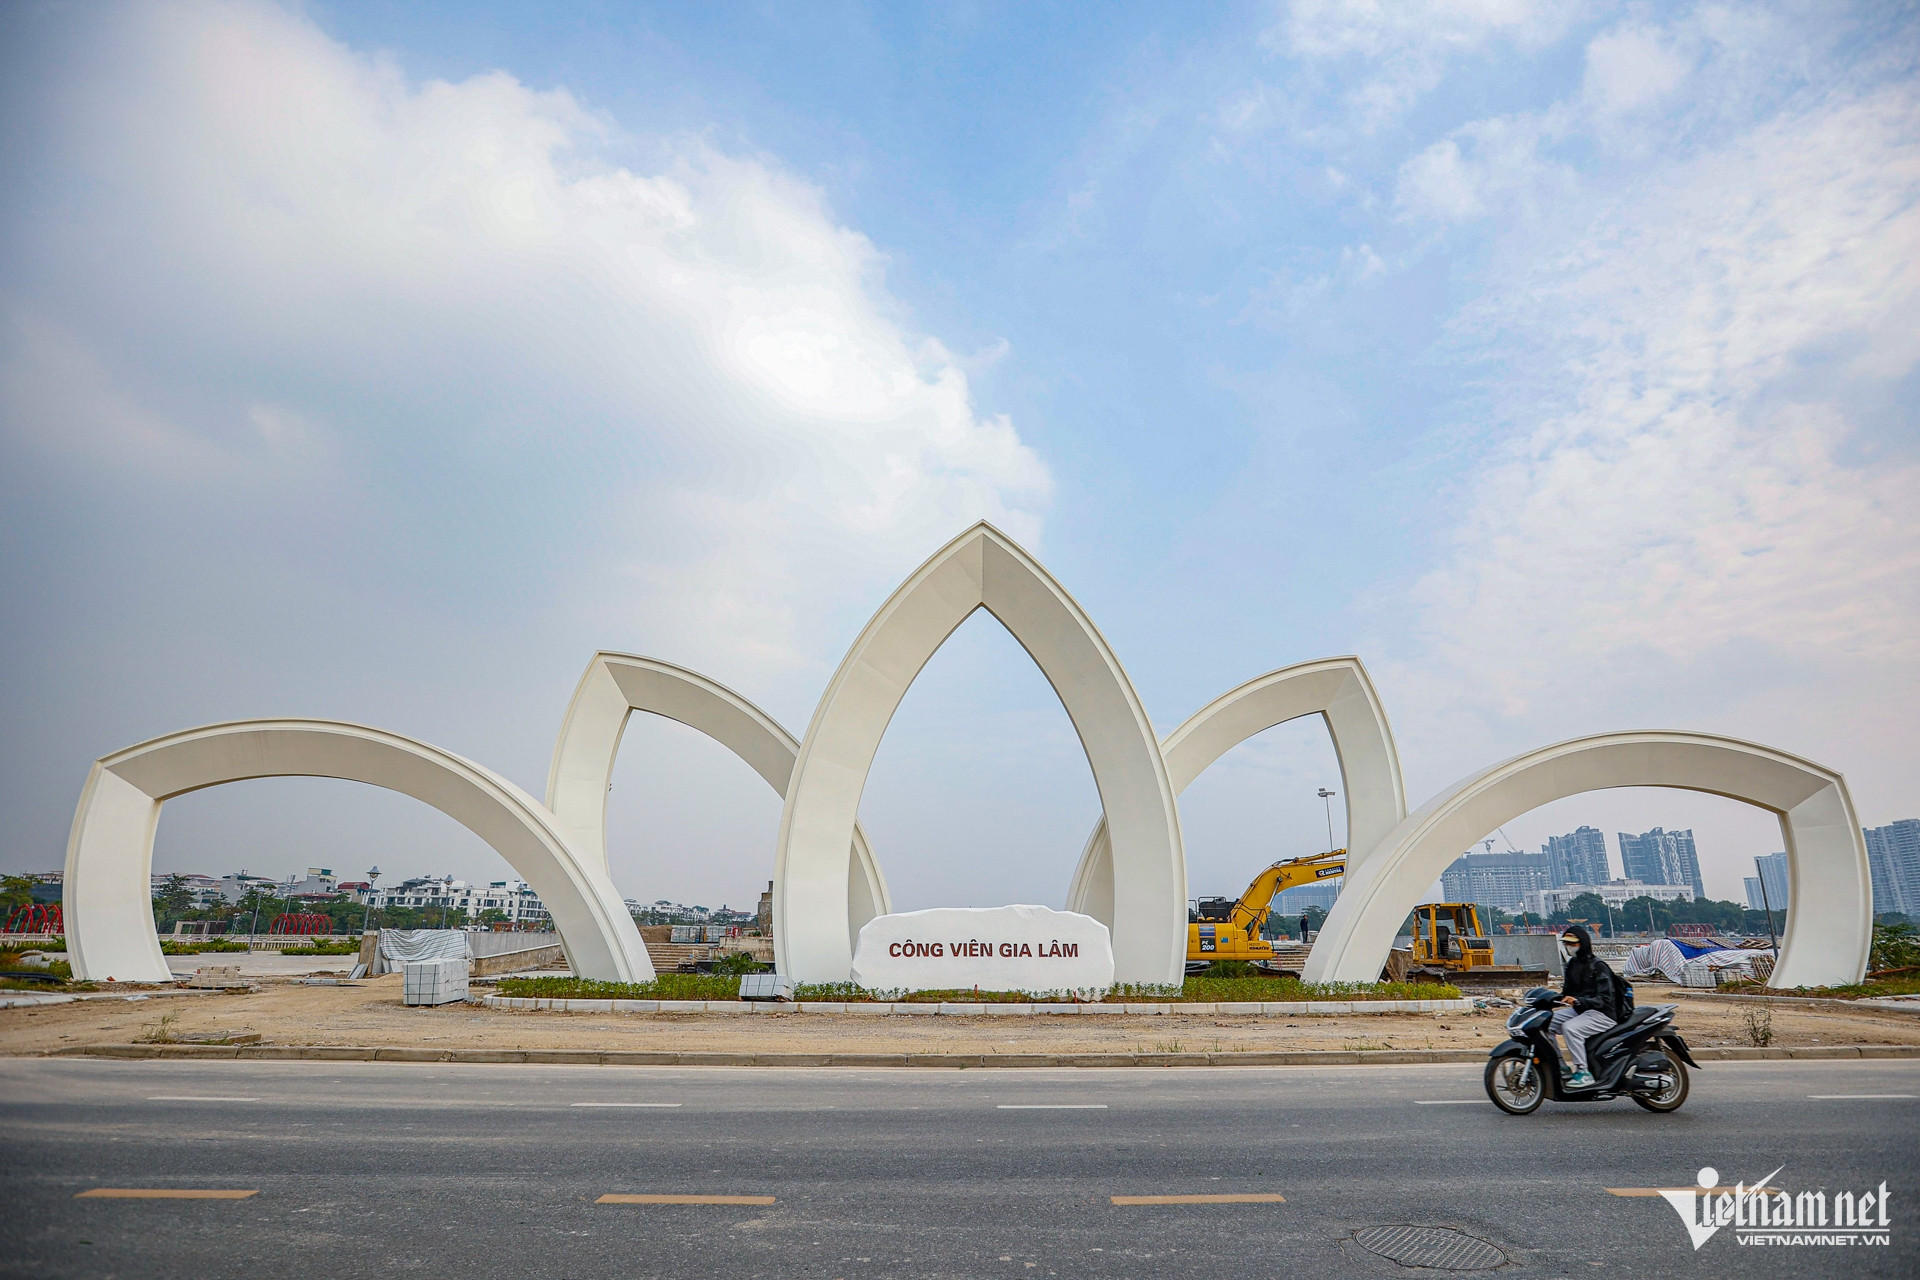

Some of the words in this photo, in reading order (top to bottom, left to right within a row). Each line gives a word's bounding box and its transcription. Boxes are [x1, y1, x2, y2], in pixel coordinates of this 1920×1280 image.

[888, 938, 944, 958] CÔNG
[949, 938, 993, 958] VIÊN
[998, 942, 1033, 958] GIA
[1038, 939, 1079, 958] LÂM
